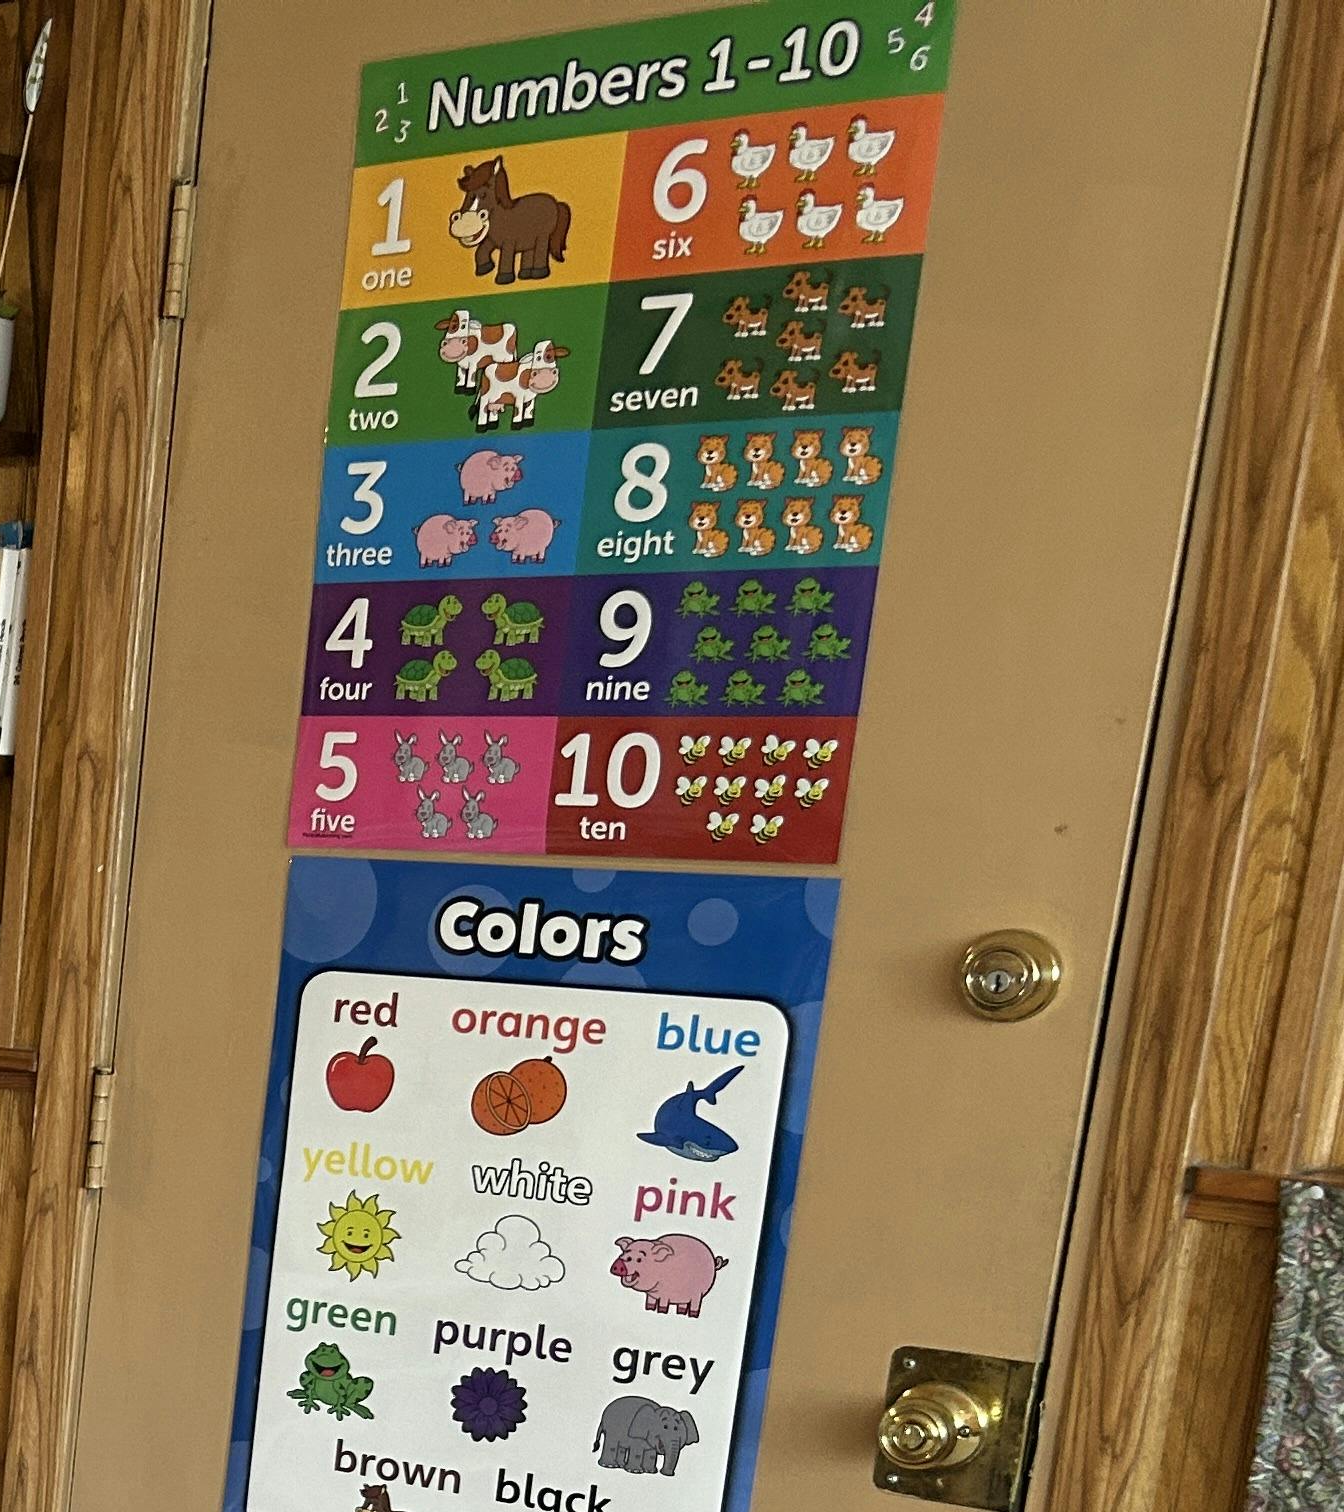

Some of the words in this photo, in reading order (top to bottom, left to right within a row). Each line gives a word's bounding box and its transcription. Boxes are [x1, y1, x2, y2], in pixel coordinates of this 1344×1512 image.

[914, 1, 935, 28] 4
[887, 28, 906, 54] 5
[910, 45, 930, 72] 6
[397, 82, 408, 105] 1
[427, 54, 687, 132] Numbers
[703, 18, 860, 96] 1-10
[375, 110, 389, 133] 2
[395, 119, 412, 144] 3
[652, 139, 709, 224] 6
[371, 178, 411, 257] 1
[653, 234, 693, 262] six
[361, 265, 412, 292] one
[638, 293, 694, 375] 7
[354, 321, 403, 399] 2
[348, 408, 400, 433] two
[610, 385, 699, 413] seven
[340, 461, 387, 535] 3
[612, 442, 671, 523] 8
[326, 543, 392, 566] three
[596, 529, 675, 564] eight
[325, 597, 373, 669] 4
[597, 589, 652, 669] 9
[319, 676, 372, 702] four
[585, 676, 651, 701] nine
[315, 730, 358, 802] 5
[554, 731, 661, 809] 10
[311, 808, 355, 832] five
[579, 816, 626, 841] ten
[437, 900, 647, 962] Colors
[333, 993, 399, 1028] red
[451, 1005, 607, 1053] orange
[656, 1012, 761, 1058] blue
[303, 1143, 434, 1185] yellow
[471, 1159, 593, 1207] white
[633, 1178, 737, 1222] pink
[285, 1296, 398, 1336] green
[433, 1318, 573, 1365] purple
[612, 1344, 714, 1394] grey
[333, 1439, 462, 1495] brown
